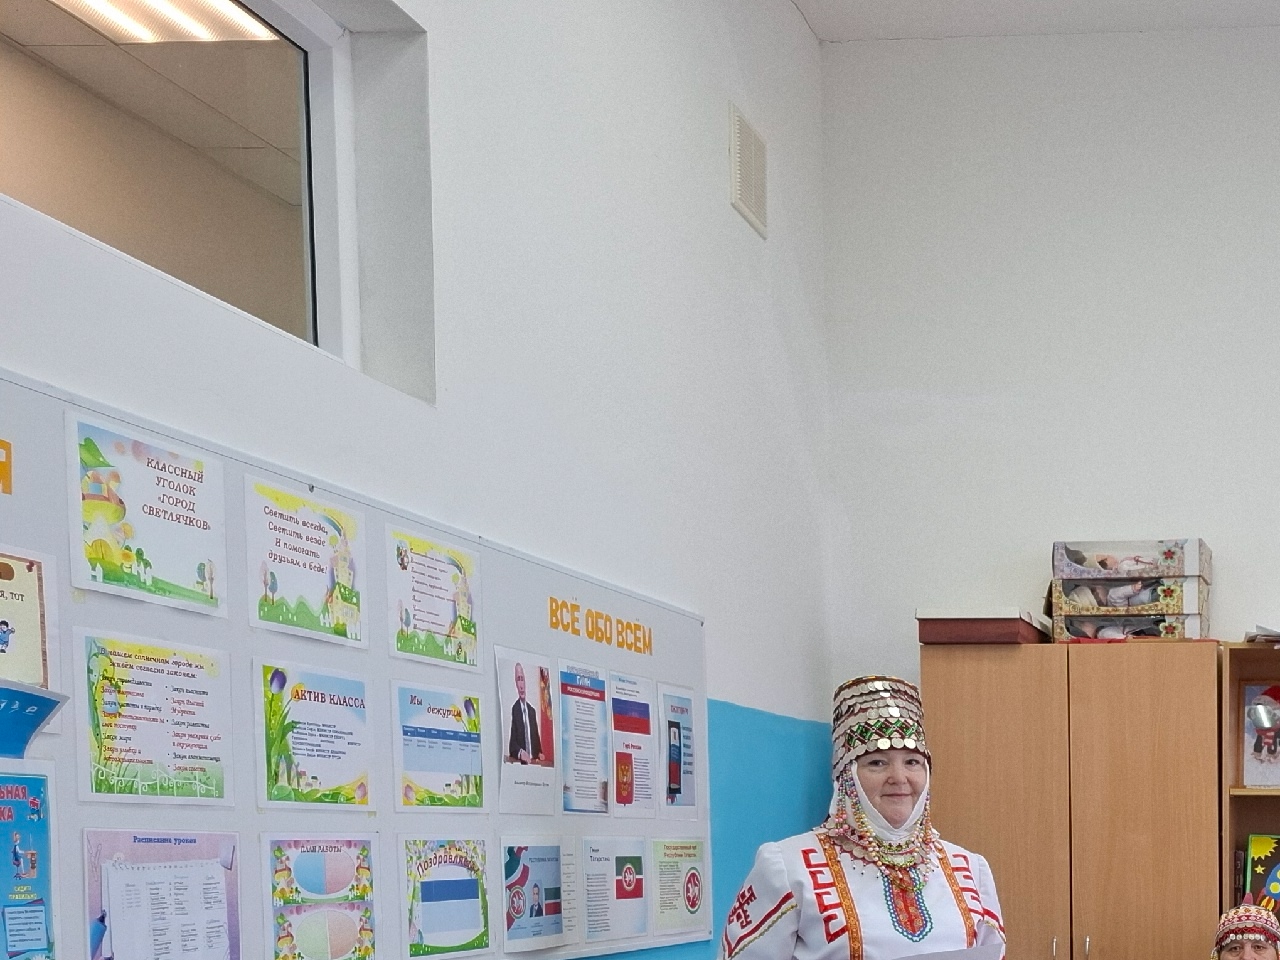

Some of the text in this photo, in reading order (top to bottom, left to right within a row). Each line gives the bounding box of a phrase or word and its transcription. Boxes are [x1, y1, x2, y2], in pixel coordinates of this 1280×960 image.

[146, 457, 204, 484] КЛАССНЫЙ
[155, 475, 196, 497] УГОЛОК
[263, 505, 300, 526] Светить
[268, 521, 304, 541] Светить
[283, 542, 320, 559] помогать
[9, 591, 25, 602] ТОТ
[585, 608, 613, 646] ОБО
[293, 688, 366, 710] АКТИВ КЛАССА
[409, 694, 423, 706] Мы
